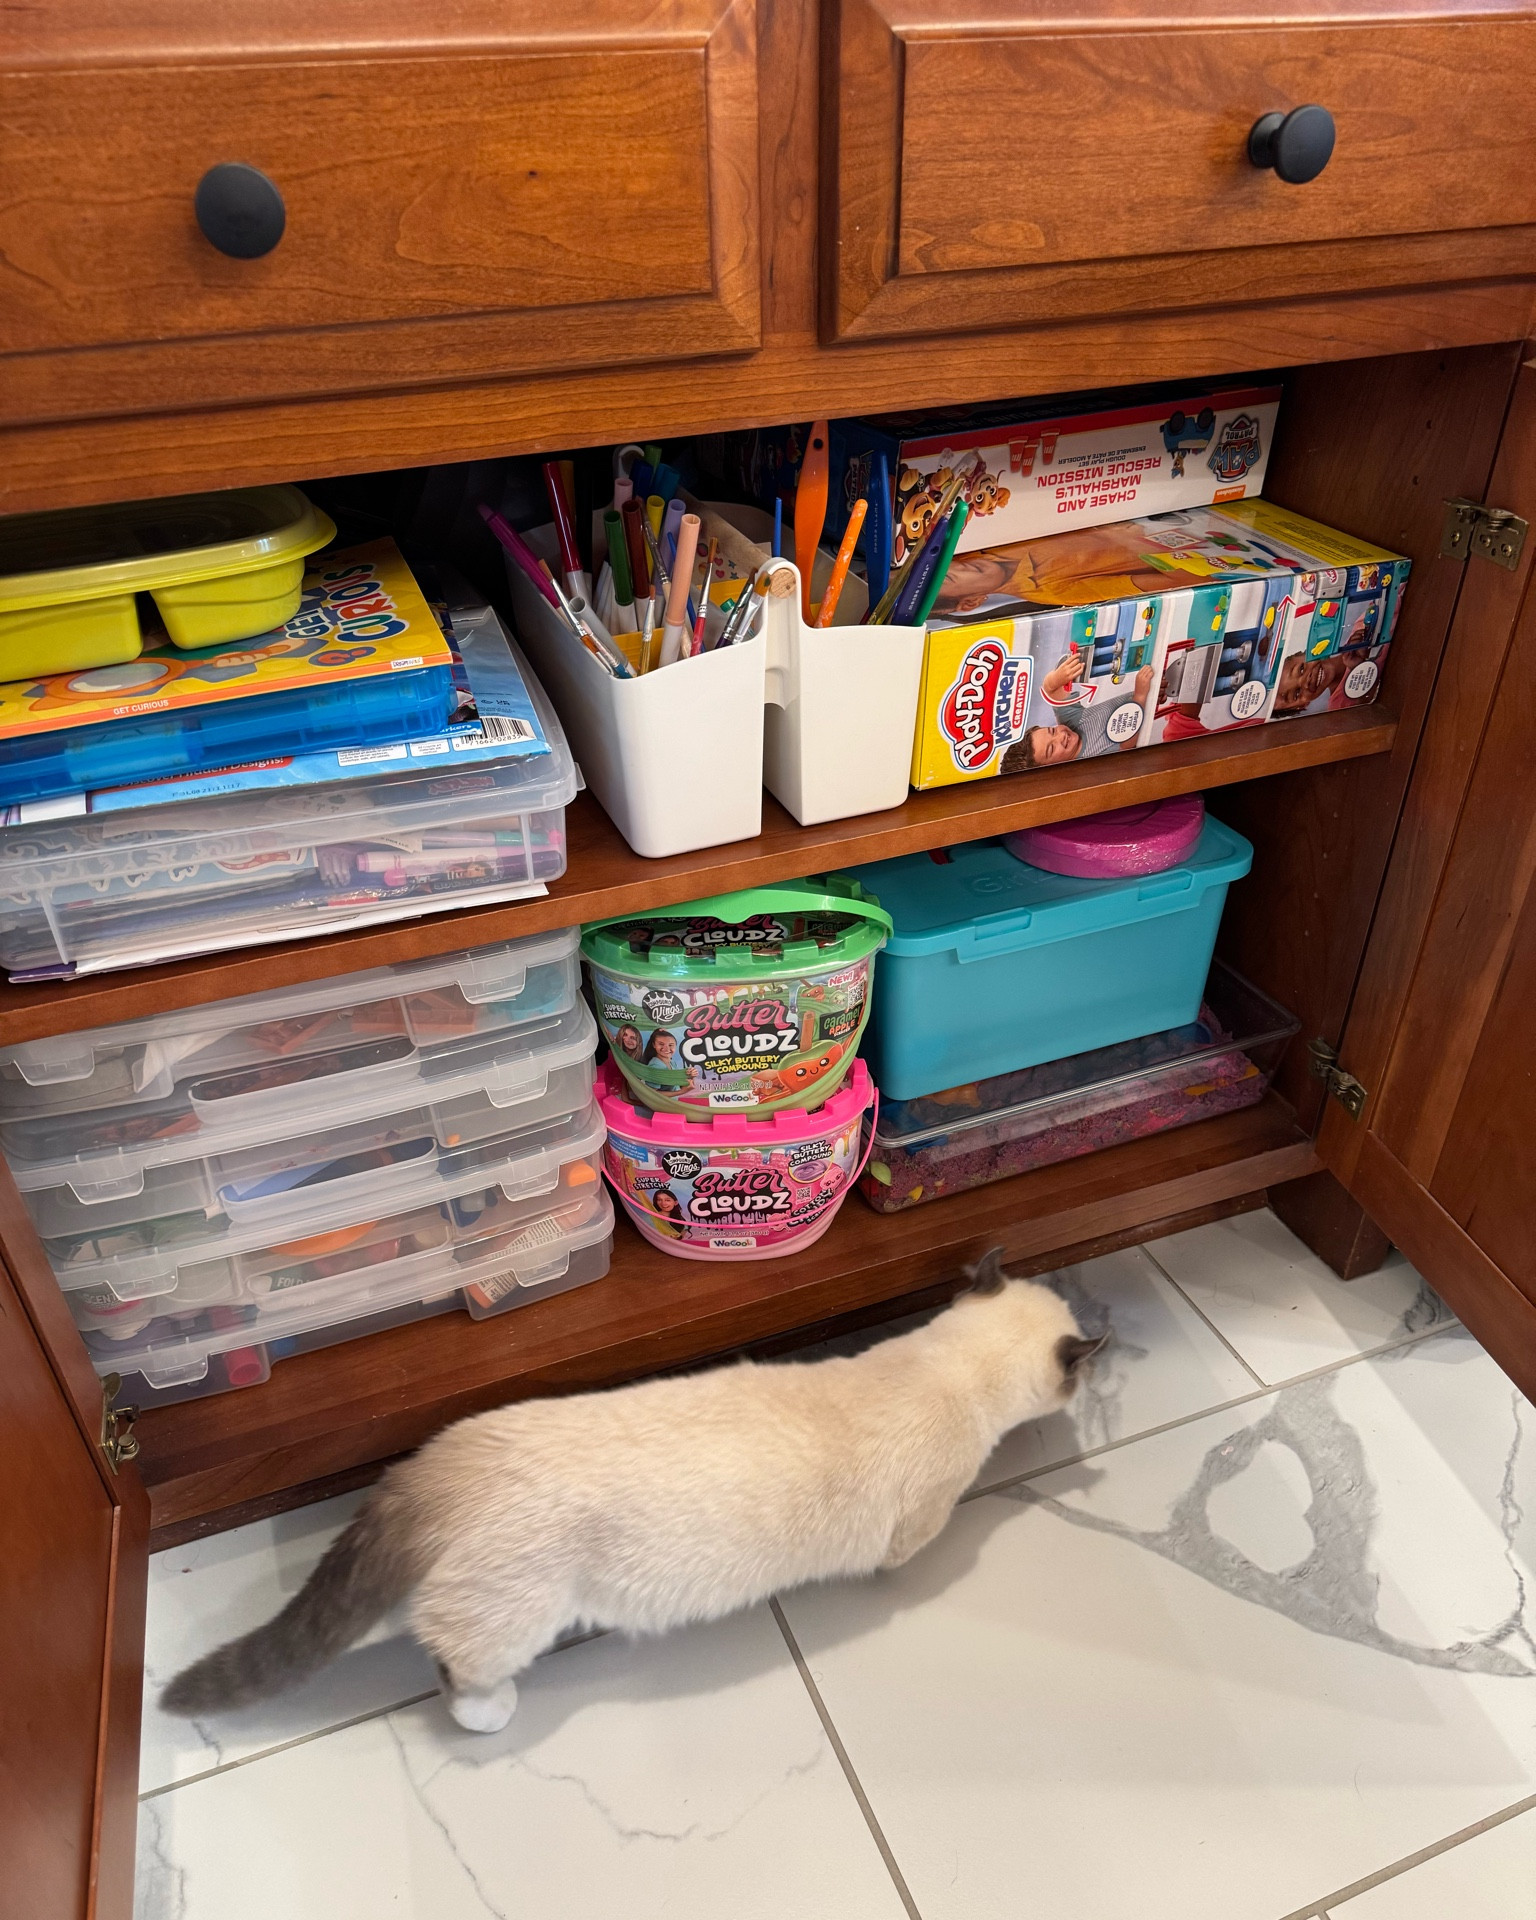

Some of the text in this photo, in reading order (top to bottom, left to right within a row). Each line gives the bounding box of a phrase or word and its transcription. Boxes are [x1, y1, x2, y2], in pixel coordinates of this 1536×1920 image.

[1225, 428, 1256, 441] PATROL
[1078, 454, 1126, 467] DOUGH PLAY SET
[1208, 440, 1262, 472] PAW
[1036, 456, 1162, 488] RESCUE MISSION
[1055, 474, 1142, 499] MARSHALL'S
[1057, 489, 1137, 513] CHASE AND
[323, 564, 409, 643] CURIOUS
[113, 699, 170, 716] GET CURIOUS
[954, 649, 999, 768] Play-Doh
[683, 928, 785, 947] CLOUDZ
[829, 971, 854, 987] NEW!
[603, 1003, 627, 1013] SUPER
[604, 1011, 636, 1021] STRETCHY
[652, 1004, 682, 1023] Kings
[686, 1000, 791, 1036] Butter
[829, 1018, 855, 1035] APPLE
[682, 1029, 799, 1062] CLOUDZ
[704, 1055, 780, 1070] SILKY BUTTERY
[716, 1062, 769, 1074] COMPOUND
[793, 1145, 831, 1159] BUTTERY
[800, 1140, 825, 1152] SILKY
[789, 1151, 832, 1167] COMPOUND
[670, 1162, 699, 1177] Kings
[634, 1182, 670, 1190] STRETCHY
[694, 1169, 789, 1198] Butter
[690, 1191, 792, 1217] CLOUDZ
[714, 1240, 752, 1248] WeCool
